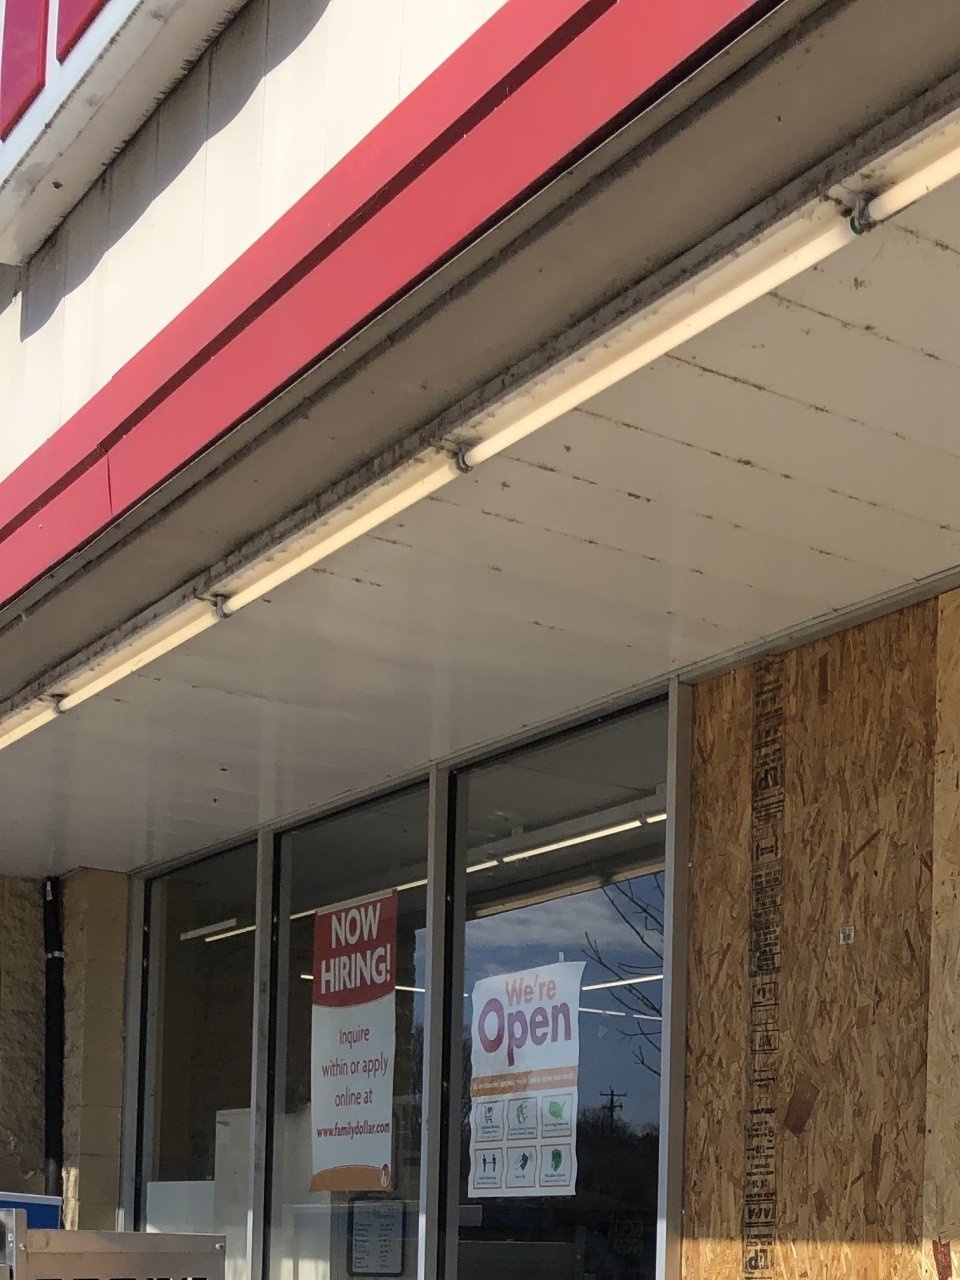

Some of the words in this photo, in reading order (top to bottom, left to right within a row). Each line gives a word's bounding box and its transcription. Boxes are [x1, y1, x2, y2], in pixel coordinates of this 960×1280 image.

[331, 902, 381, 949] NOW
[321, 944, 391, 994] HIRING!
[505, 974, 556, 1007] We're
[339, 1025, 370, 1049] Inquire
[478, 998, 572, 1067] Open
[322, 1060, 348, 1079] within
[350, 1059, 361, 1073] or
[362, 1055, 389, 1077] apply
[335, 1088, 361, 1108] online
[363, 1087, 373, 1104] at
[316, 1121, 391, 1140] www.familydollar.com
